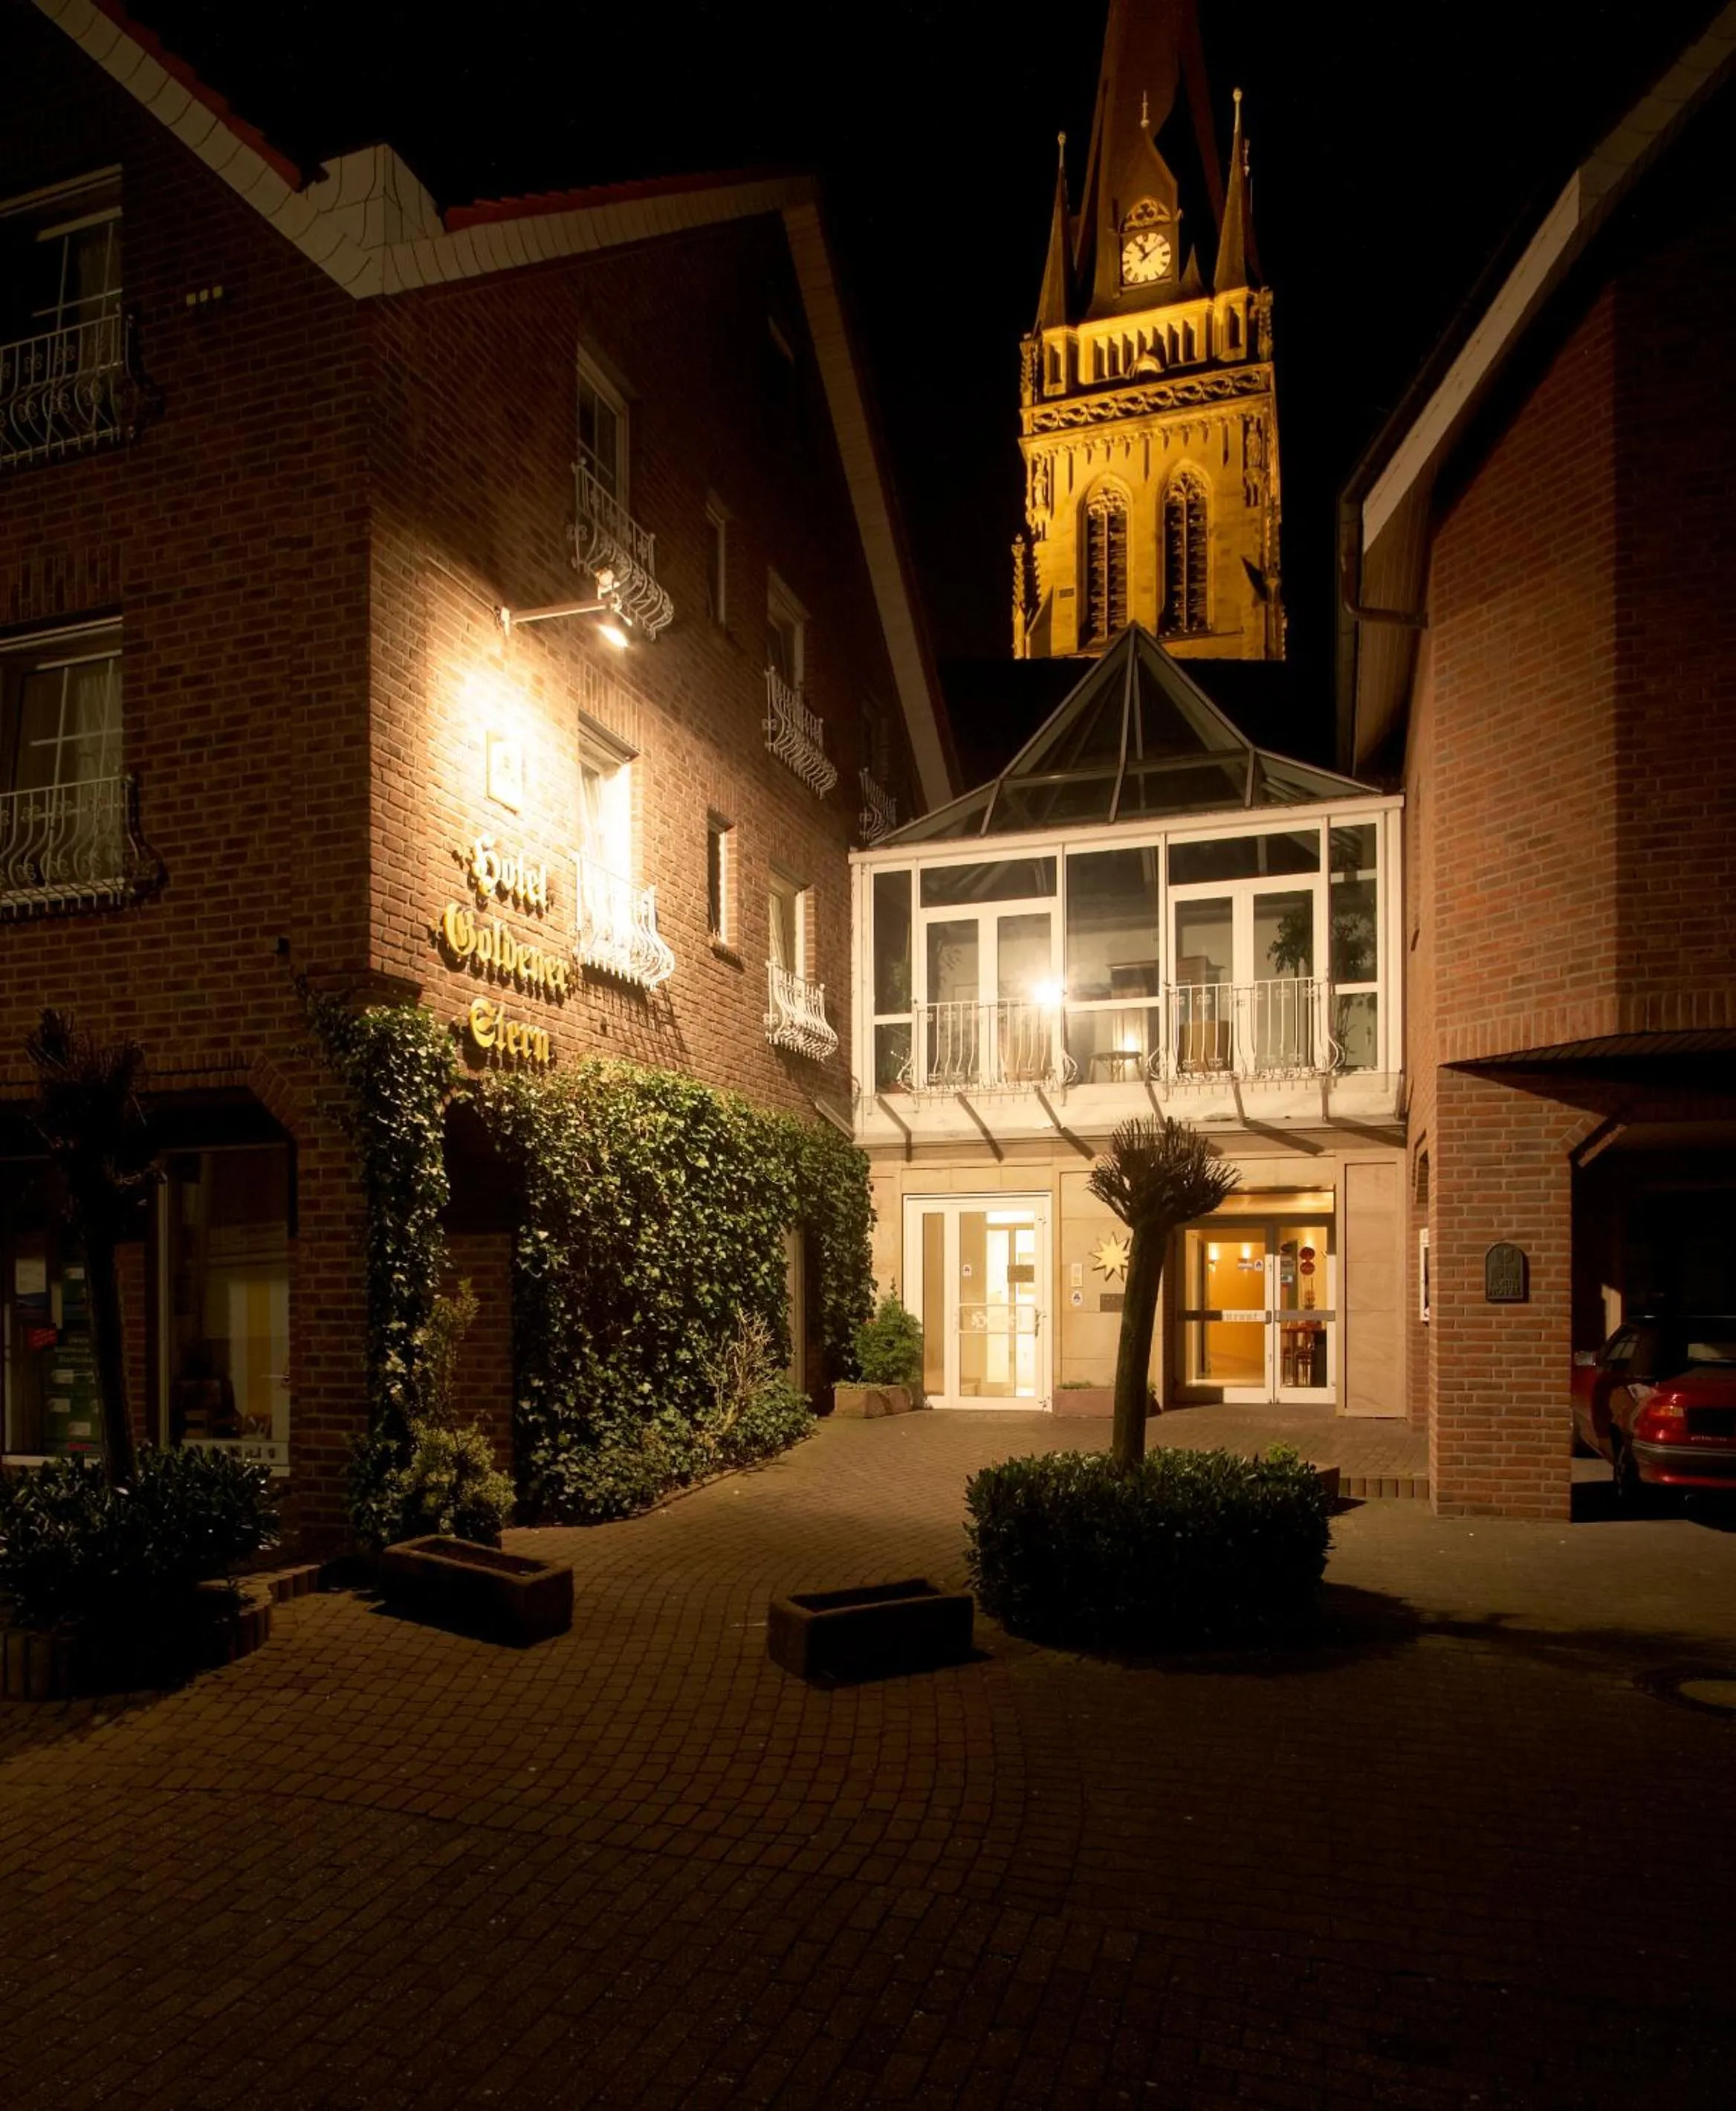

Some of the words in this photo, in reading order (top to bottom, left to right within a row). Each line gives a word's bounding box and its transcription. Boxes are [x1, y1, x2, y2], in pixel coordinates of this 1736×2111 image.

[471, 833, 548, 907] Hotel
[444, 902, 570, 992] Goldener
[470, 998, 550, 1064] Stern
